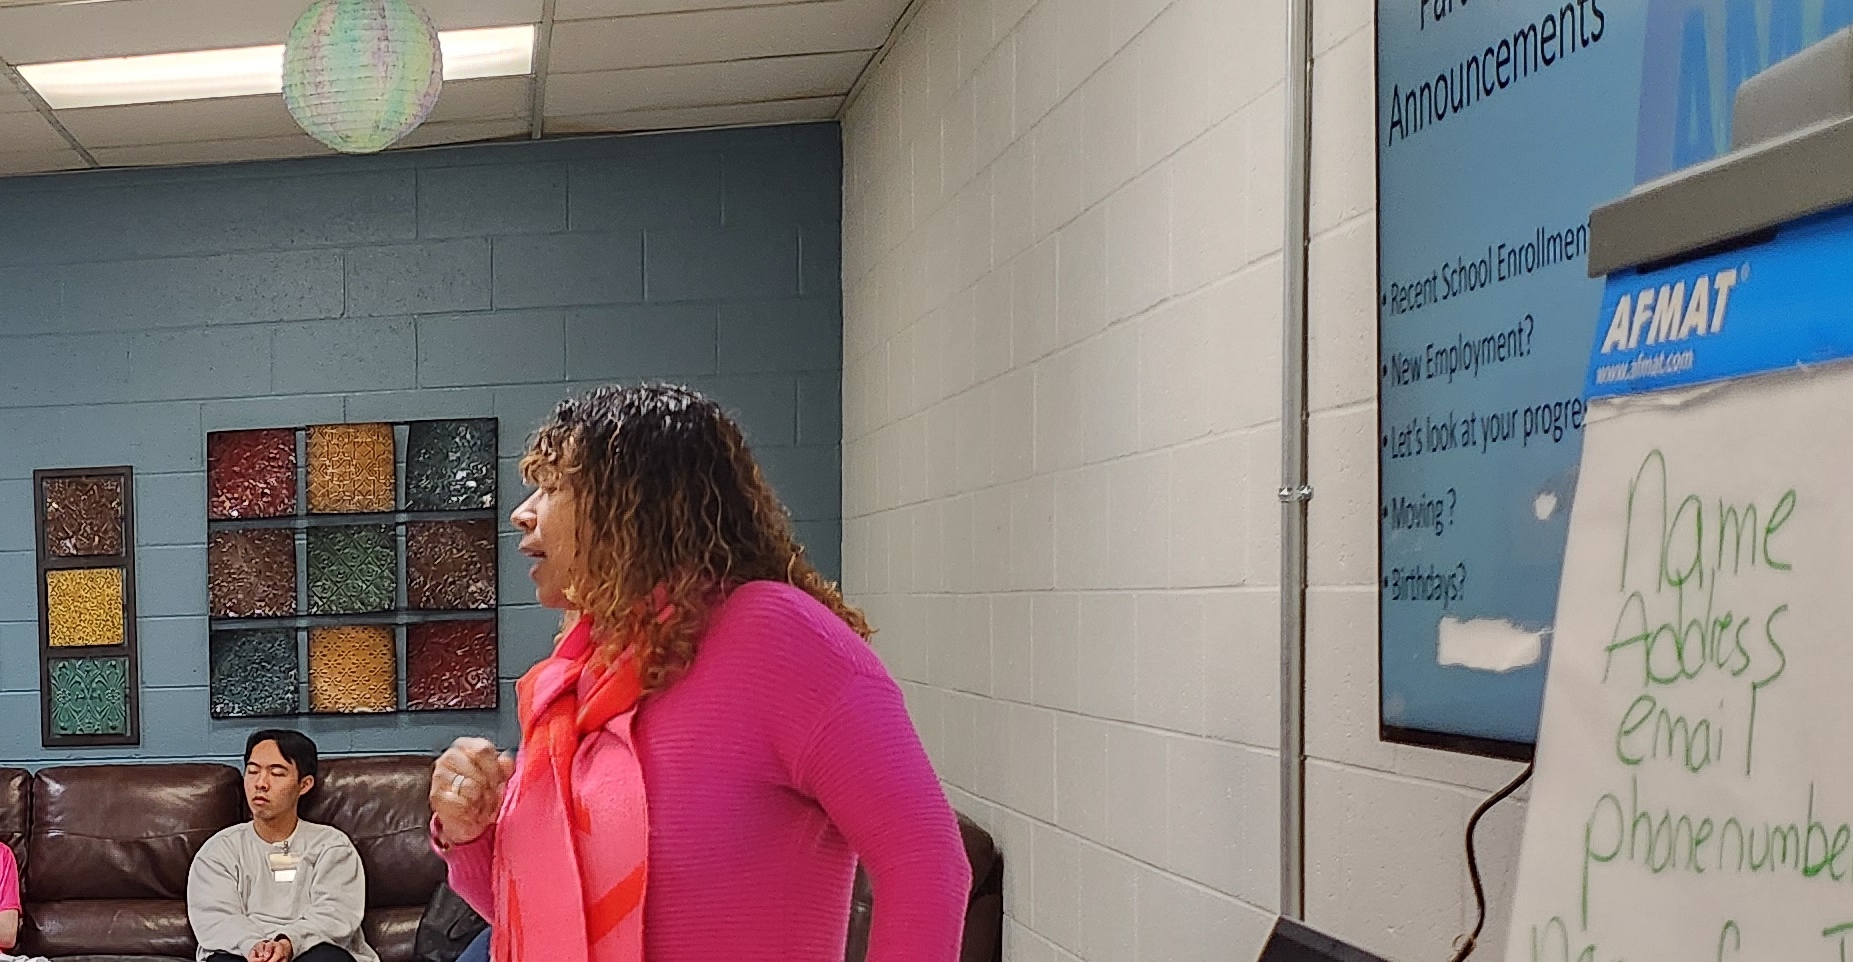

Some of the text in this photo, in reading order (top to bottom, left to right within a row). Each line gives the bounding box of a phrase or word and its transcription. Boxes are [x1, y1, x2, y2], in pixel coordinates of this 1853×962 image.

[1388, 0, 1604, 146] Announcements
[1390, 220, 1590, 316] Recent School Enrollmen
[1600, 267, 1737, 354] AFMAT
[1391, 313, 1534, 387] New Employment?
[1596, 348, 1694, 384] www.afmat.com
[1391, 397, 1587, 459] Let's look at your progre
[1391, 492, 1444, 536] Moving
[1620, 448, 1797, 593] Name
[1391, 560, 1467, 611] Birthdays?
[1602, 566, 1788, 688] Address
[1616, 682, 1757, 777] email
